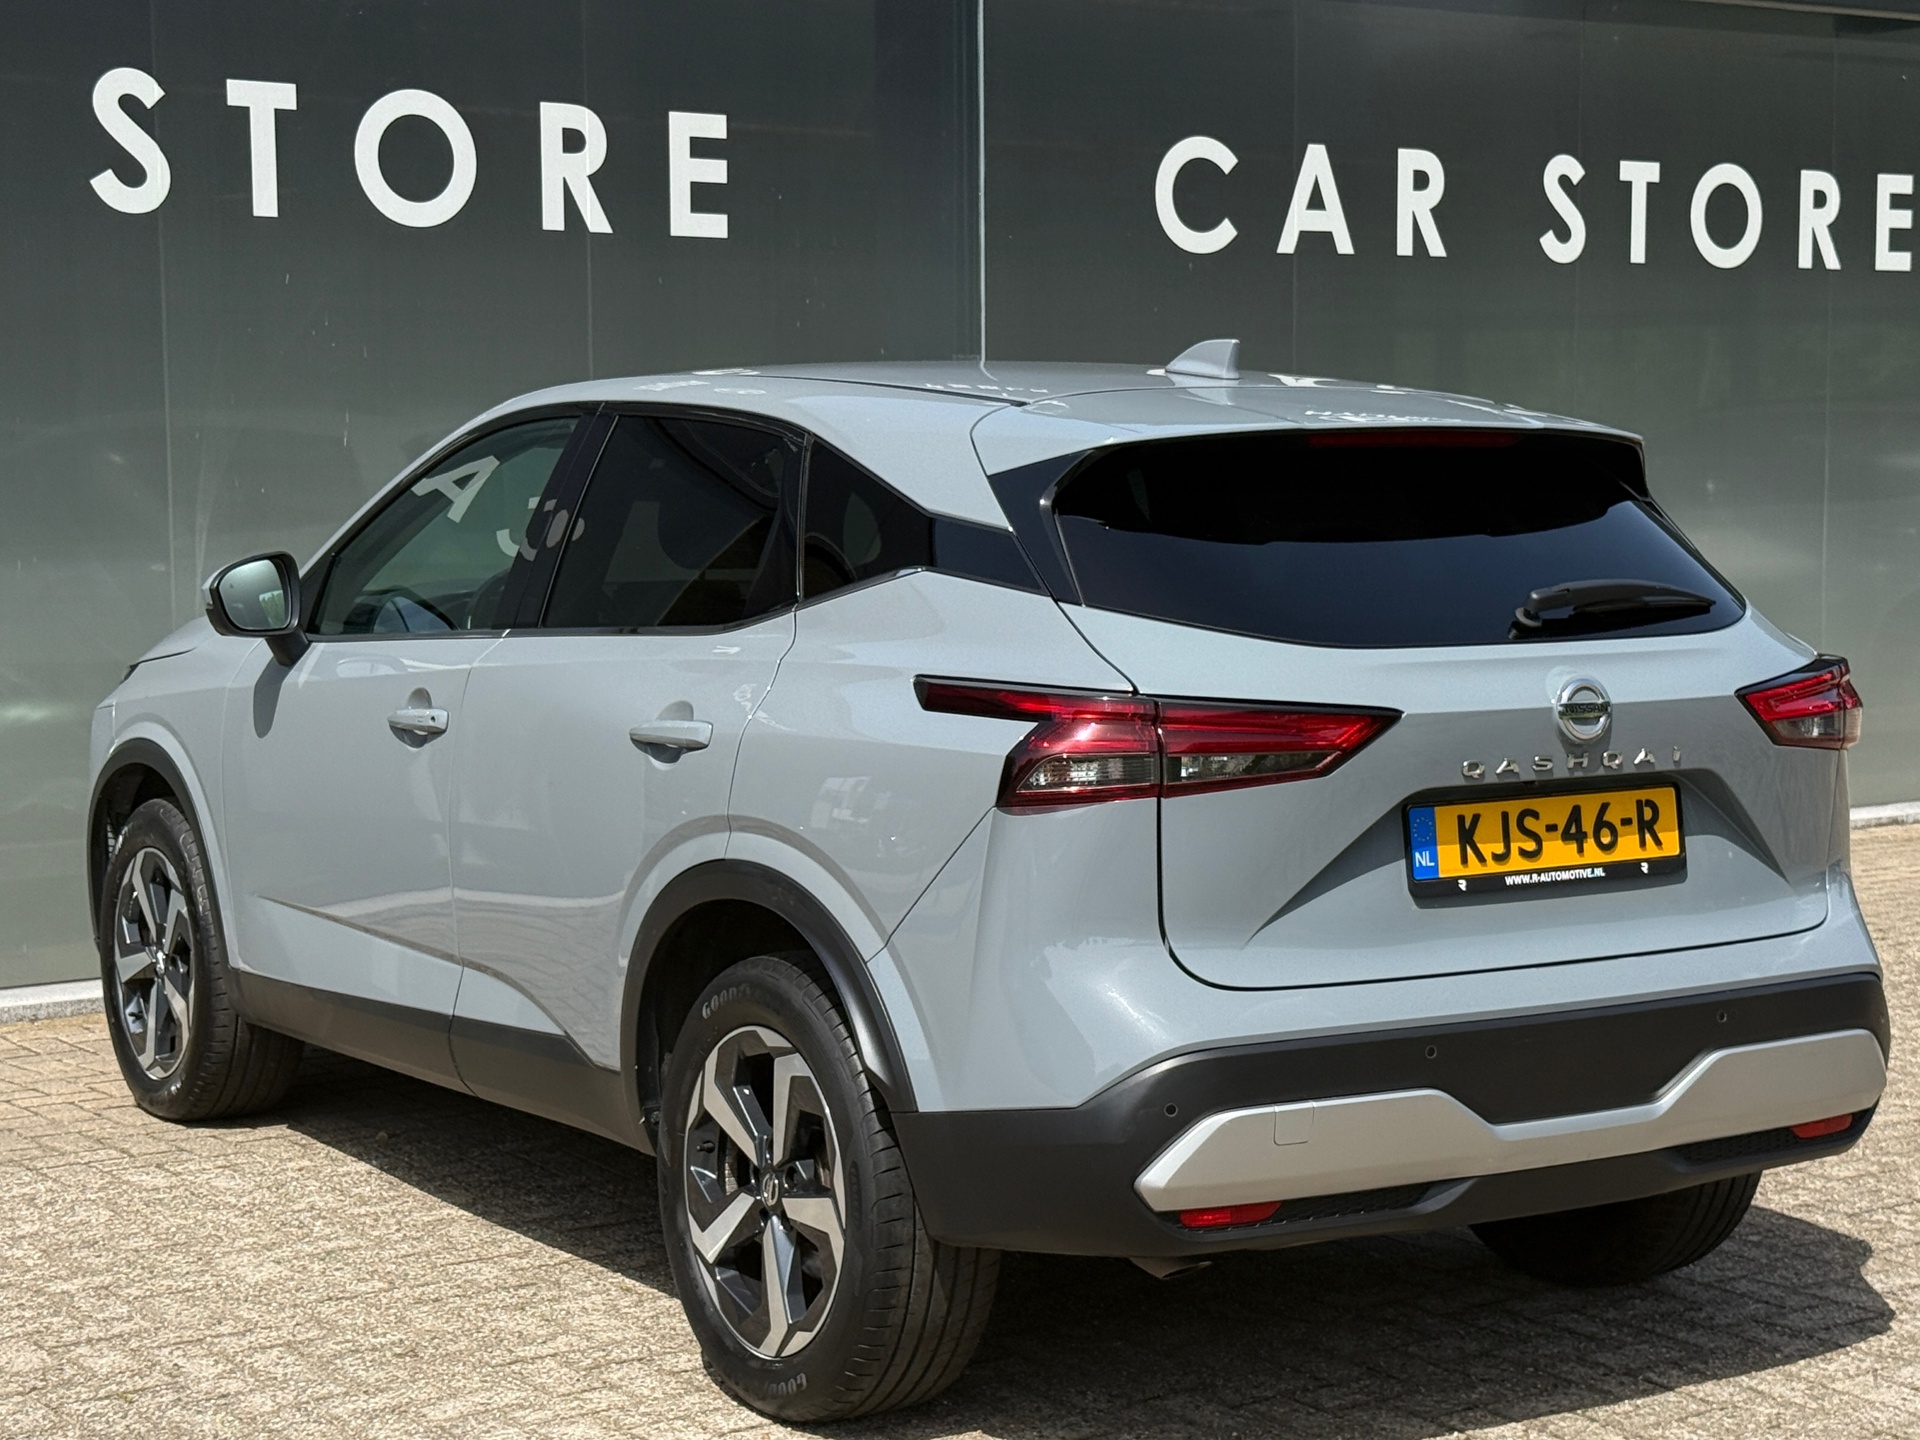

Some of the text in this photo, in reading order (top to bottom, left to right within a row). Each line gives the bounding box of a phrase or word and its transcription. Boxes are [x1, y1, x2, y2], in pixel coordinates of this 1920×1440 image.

[90, 66, 729, 239] STORE
[1155, 135, 1913, 272] CAR STORE
[1564, 702, 1609, 714] NISSAN
[1456, 799, 1662, 866] KJS-46-R
[1415, 851, 1435, 868] NL
[1505, 867, 1606, 886] WWW.R-AUTOMOTIVE.NL
